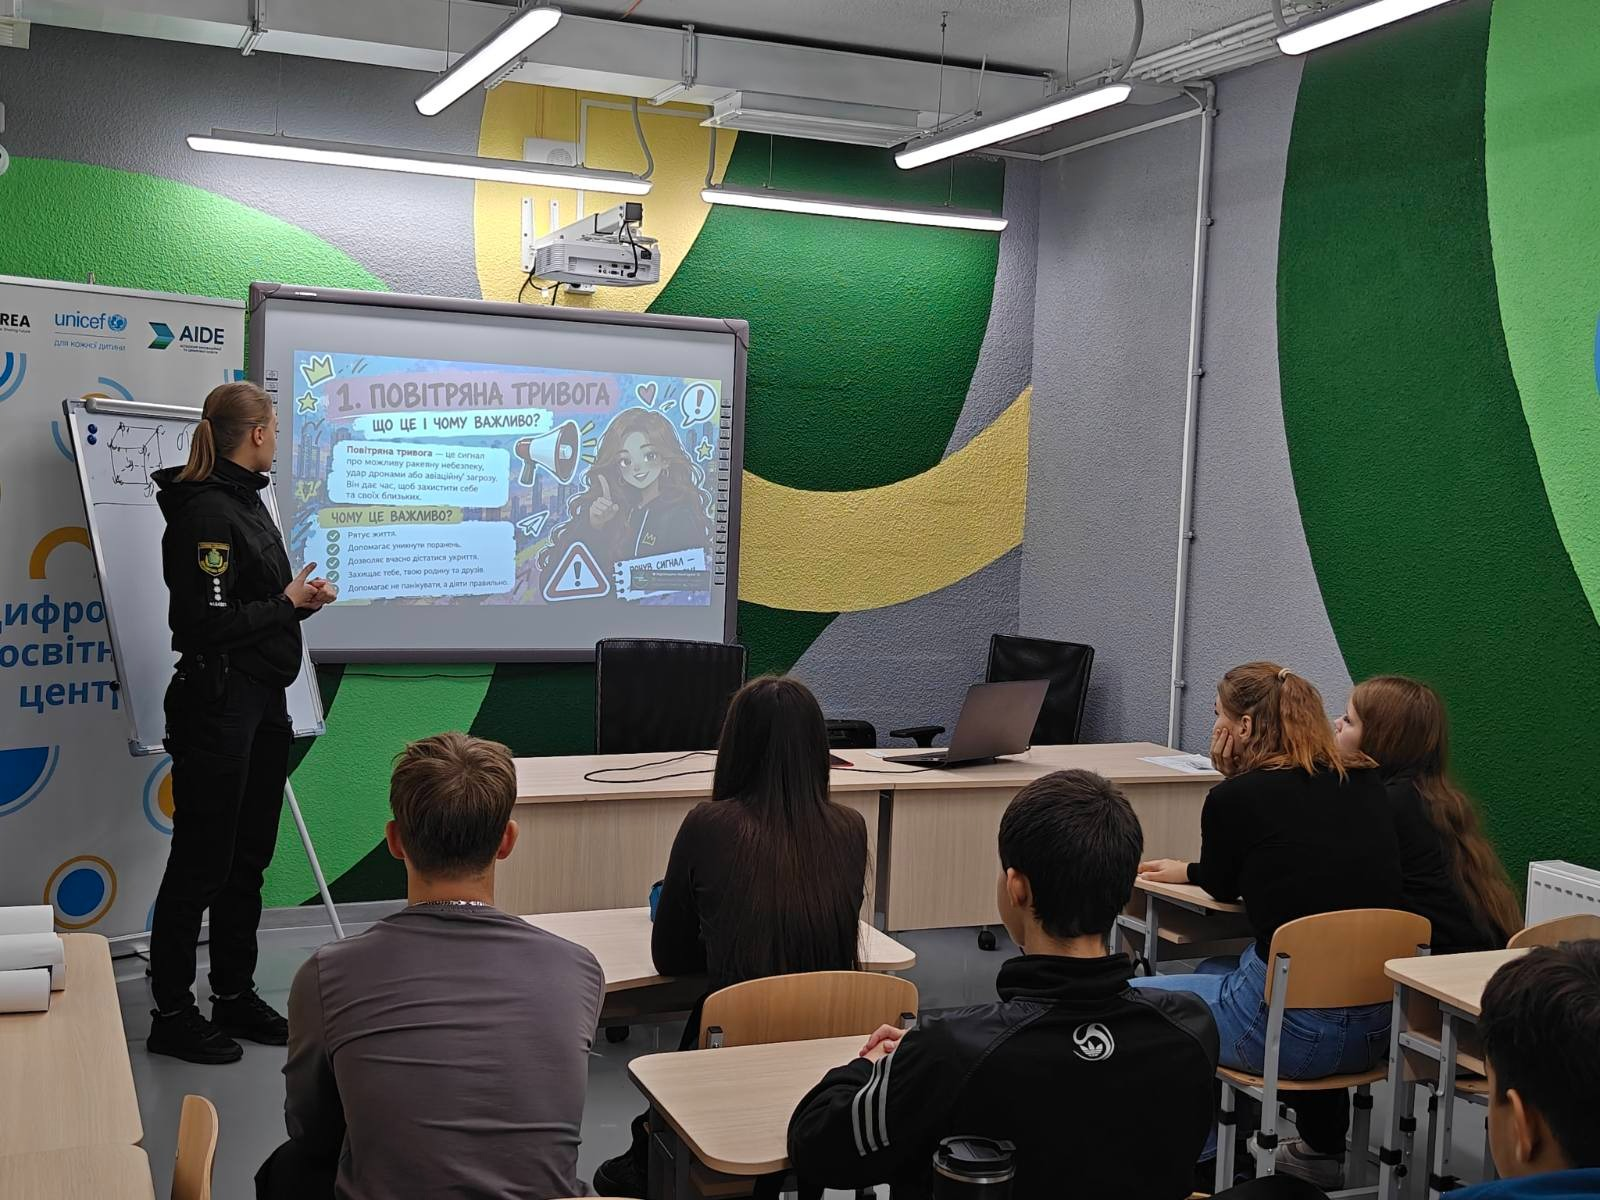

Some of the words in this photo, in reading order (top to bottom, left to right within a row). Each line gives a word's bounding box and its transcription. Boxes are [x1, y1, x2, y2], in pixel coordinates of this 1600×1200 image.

[0, 312, 31, 328] REA
[54, 310, 107, 330] unicef
[179, 325, 225, 345] AIDE
[336, 382, 362, 412] 1.
[369, 381, 504, 409] ПОВІТРЯНА
[511, 381, 611, 407] ТРИВОГА
[372, 418, 394, 433] ЩО
[400, 418, 417, 432] ЦЕ
[433, 416, 468, 430] ЧОМУ
[474, 413, 541, 429] ВАЖЛИВО?
[346, 445, 394, 456] Повітряна
[396, 448, 433, 458] тривога
[445, 451, 456, 459] це
[457, 451, 485, 460] сигнал
[346, 458, 363, 466] про
[364, 459, 404, 469] можливу
[345, 470, 367, 478] удар
[368, 470, 406, 479] дронами
[407, 470, 423, 479] або
[346, 480, 360, 489] Він
[361, 481, 378, 490] дає
[398, 482, 415, 491] щоб
[416, 484, 458, 492] захистити
[459, 484, 479, 492] себе
[357, 491, 379, 500] своїх
[331, 511, 363, 524] ЧОМУ
[368, 510, 385, 524] ЦЕ
[390, 509, 454, 523] ВАЖЛИВО?
[347, 543, 392, 552] Допомагає
[392, 542, 425, 551] уникнути
[347, 557, 385, 566] Дозволяє
[412, 554, 447, 563] дістатися
[656, 557, 684, 570] СИГНАЛ
[403, 568, 422, 576] твою
[423, 568, 449, 576] родину
[347, 584, 390, 592] Допомагає
[0, 594, 105, 634] ифро
